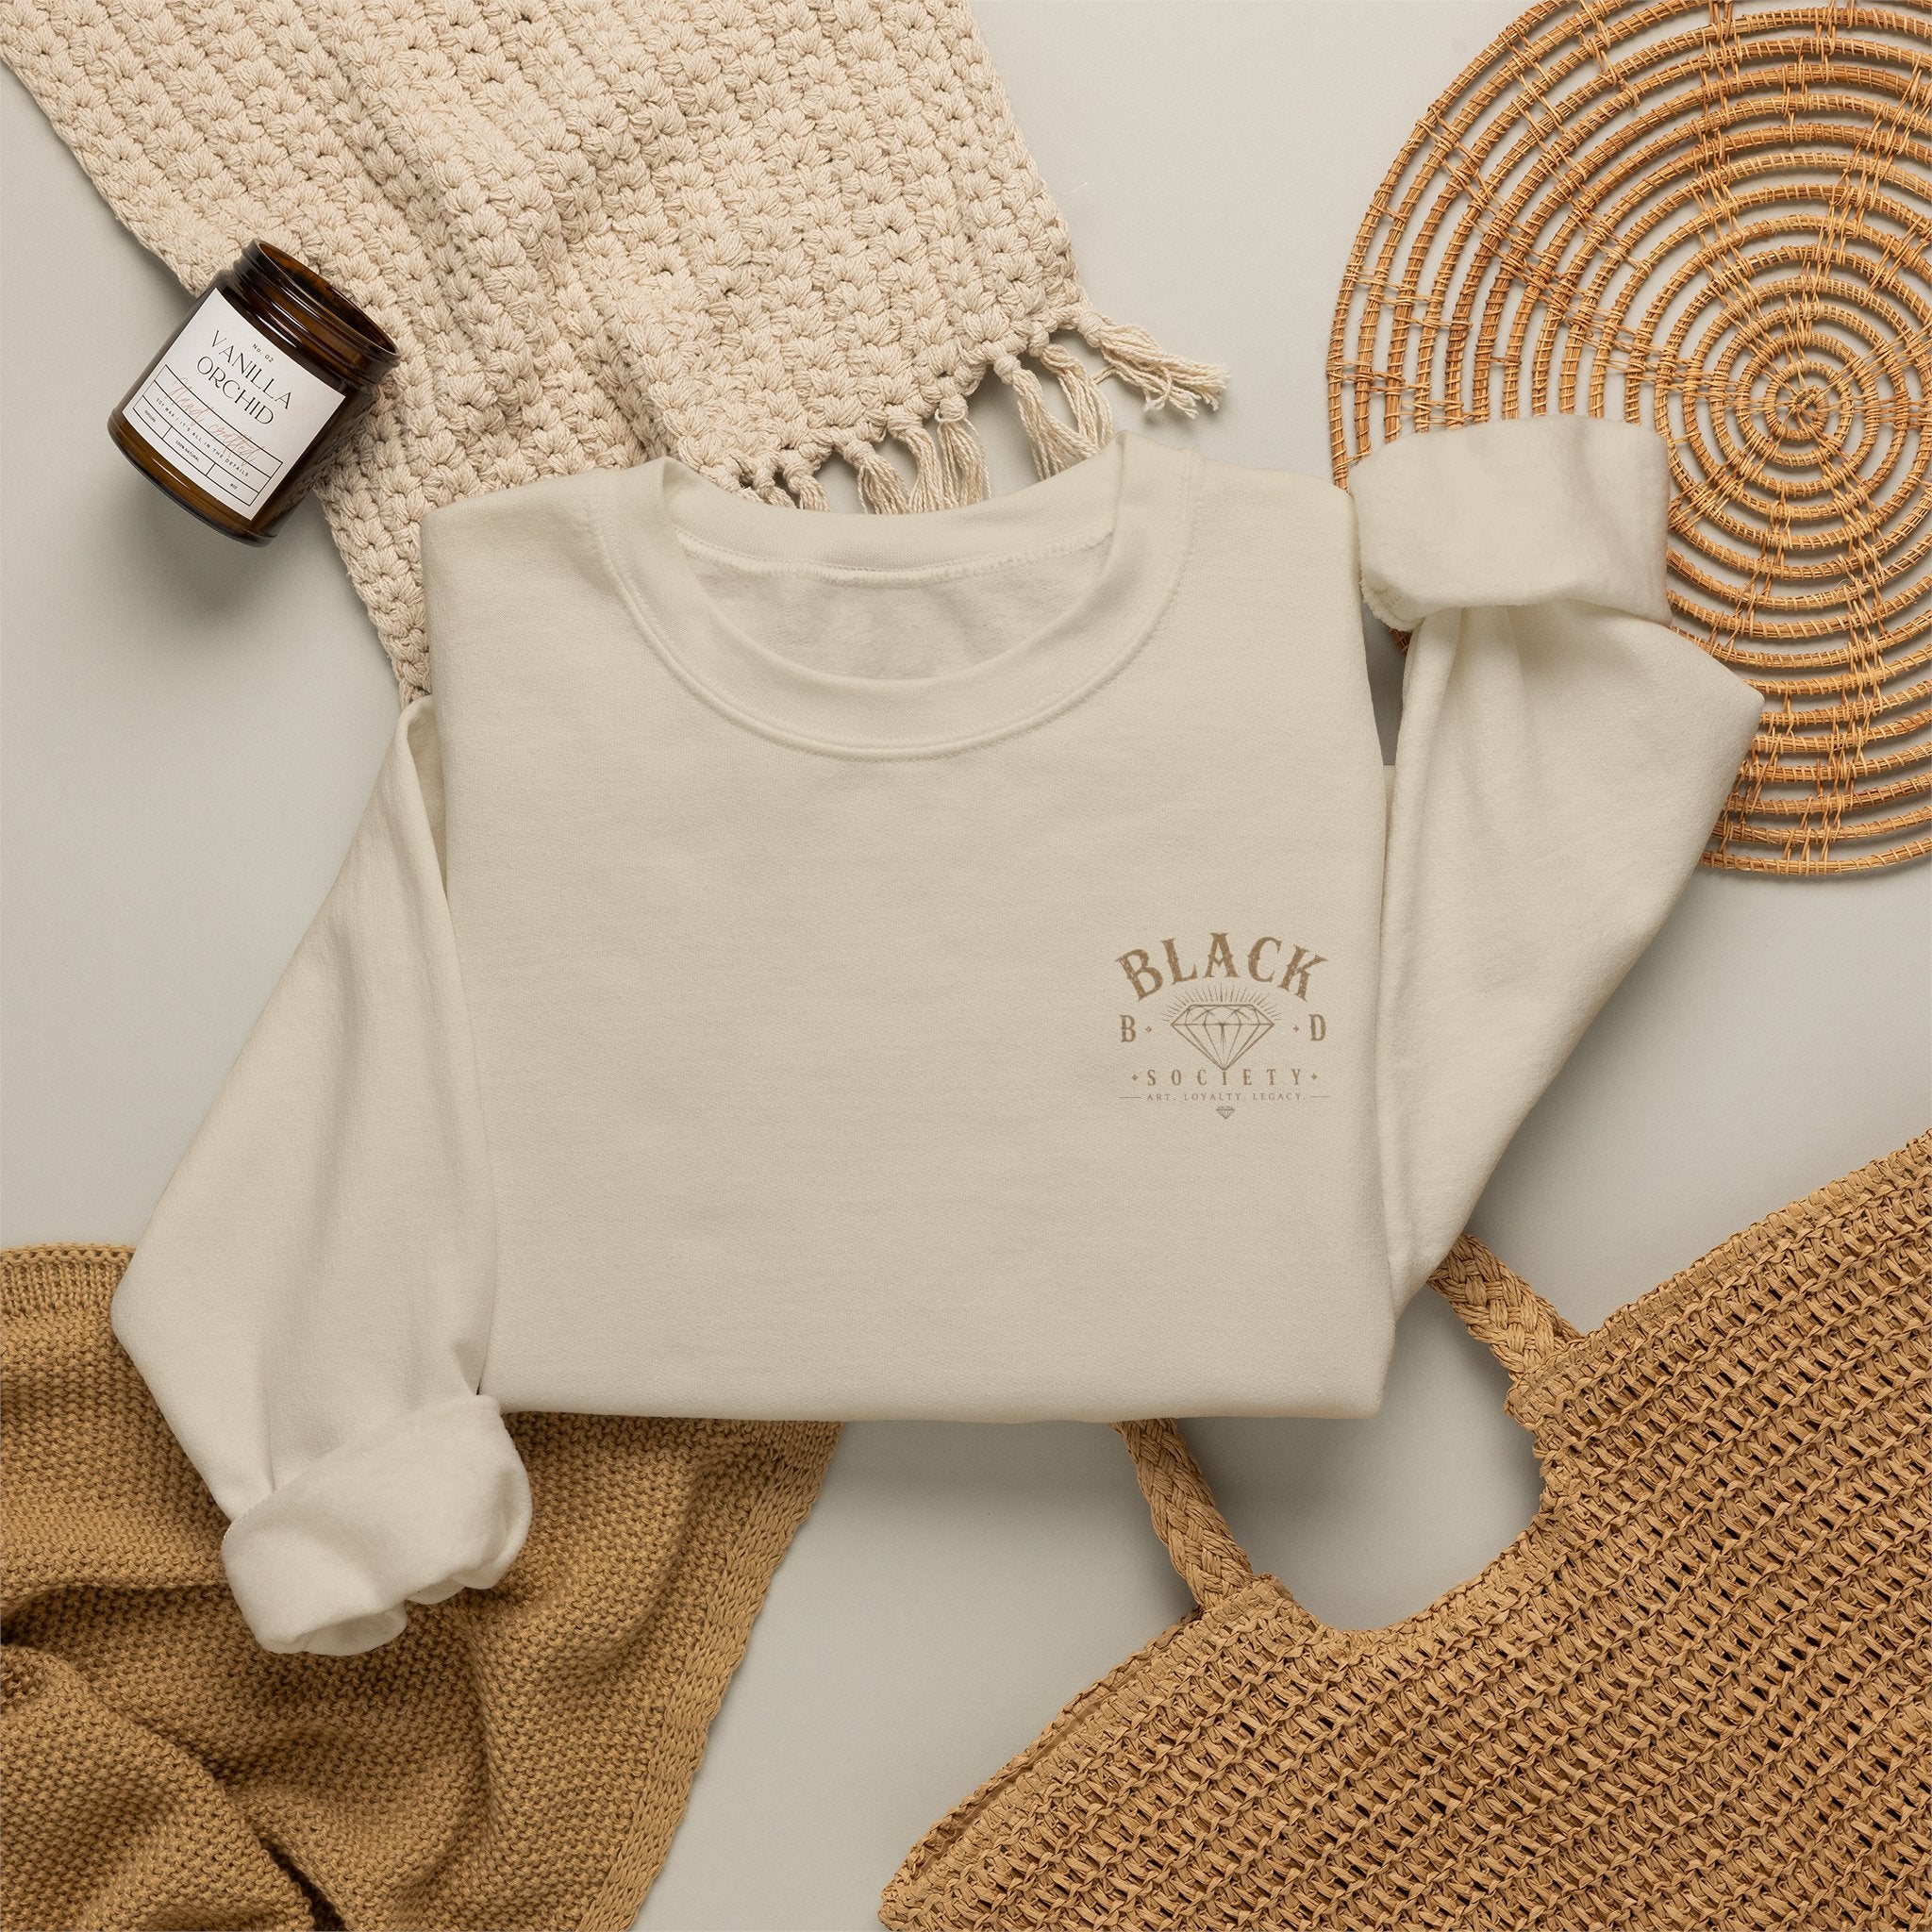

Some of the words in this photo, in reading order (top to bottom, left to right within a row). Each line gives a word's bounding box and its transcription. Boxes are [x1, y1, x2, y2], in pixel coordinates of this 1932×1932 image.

[212, 330, 291, 409] VANILLA
[252, 343, 262, 354] No.
[264, 354, 275, 363] 02
[196, 357, 274, 425] ORCHID
[192, 432, 202, 441] ALL
[212, 448, 223, 458] THE
[225, 458, 249, 476] DETAILS
[1115, 932, 1328, 1003] BLACK
[1120, 1014, 1137, 1042] B
[1308, 1013, 1326, 1041] D
[1147, 1068, 1301, 1086] SOCIETY
[1146, 1092, 1177, 1101] ART.
[1253, 1091, 1306, 1101] LEGACY.
